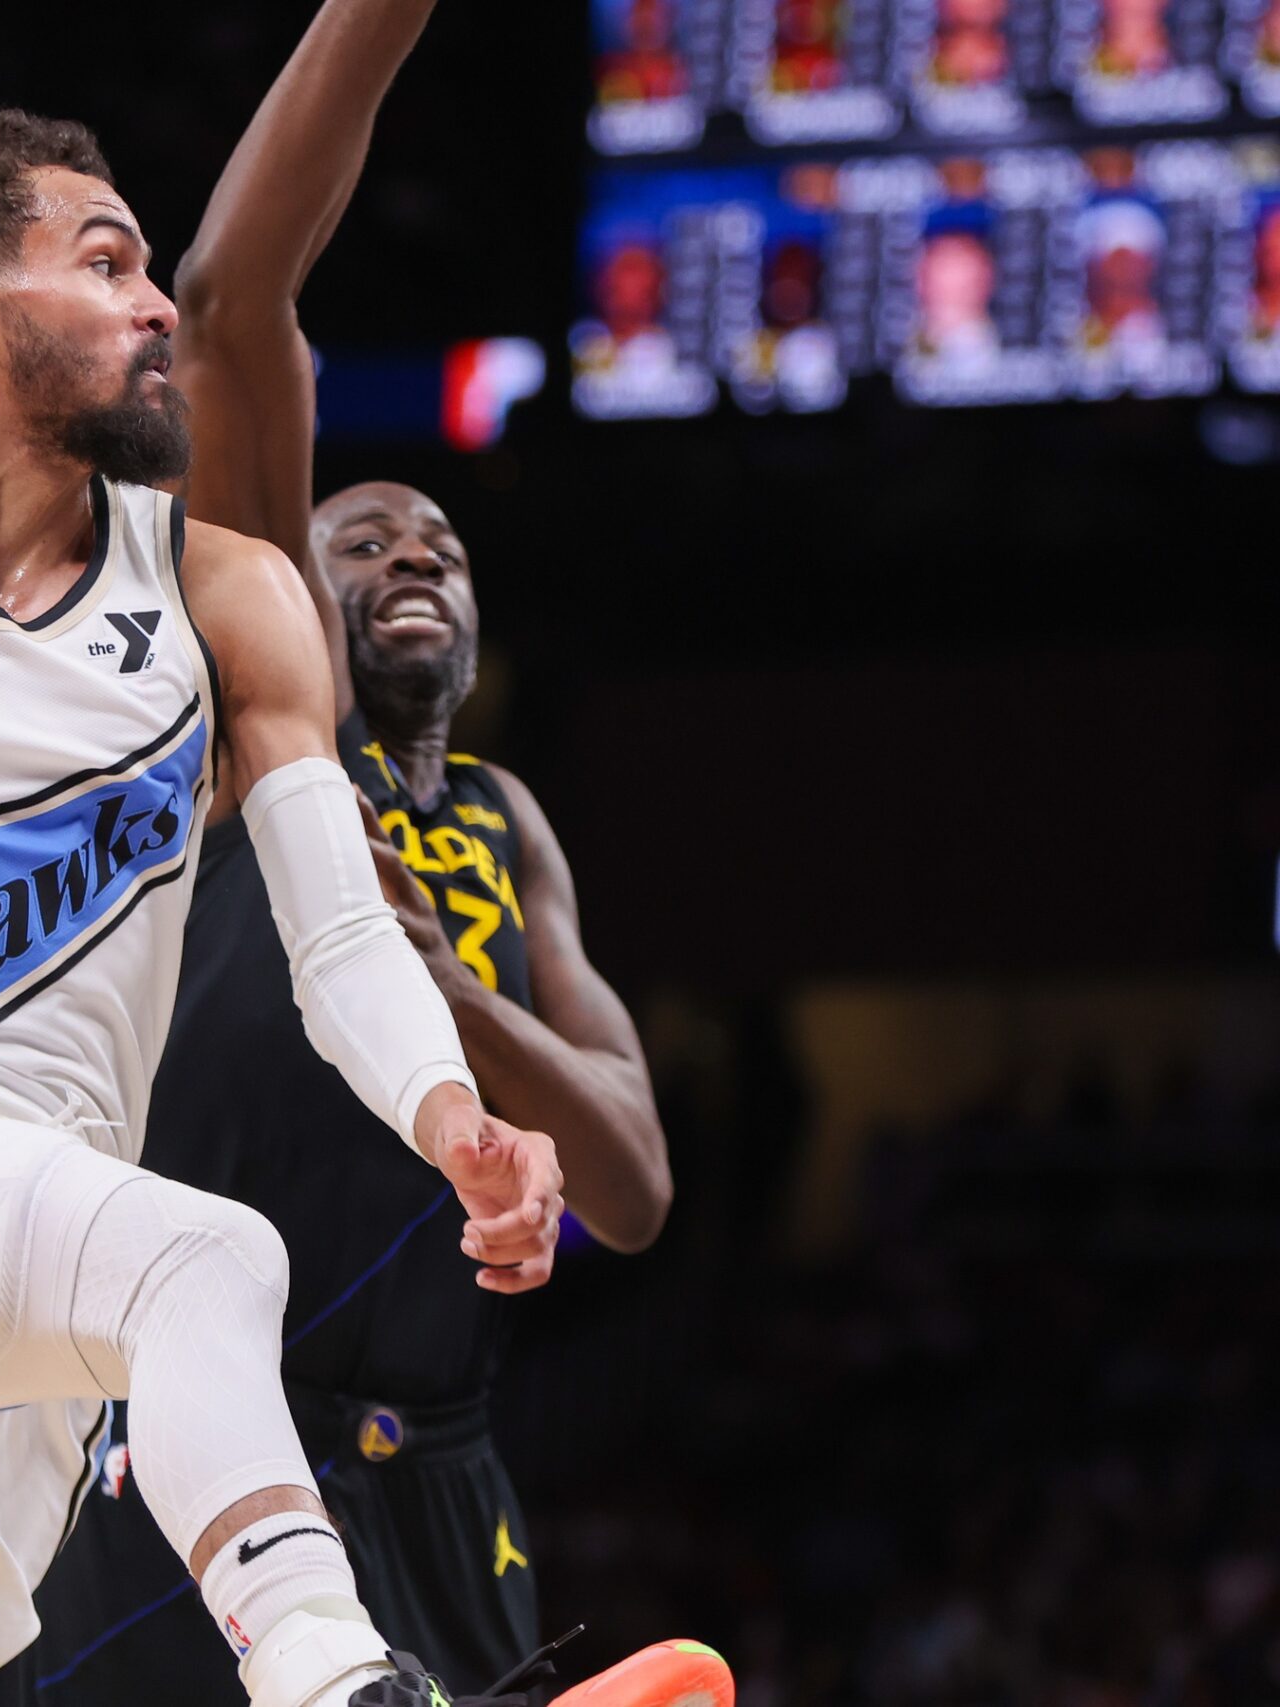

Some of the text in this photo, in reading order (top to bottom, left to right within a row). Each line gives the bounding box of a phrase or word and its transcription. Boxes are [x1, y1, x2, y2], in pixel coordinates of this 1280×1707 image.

[88, 610, 162, 674] the Y
[378, 809, 525, 931] OLDEN
[416, 876, 502, 992] 3
